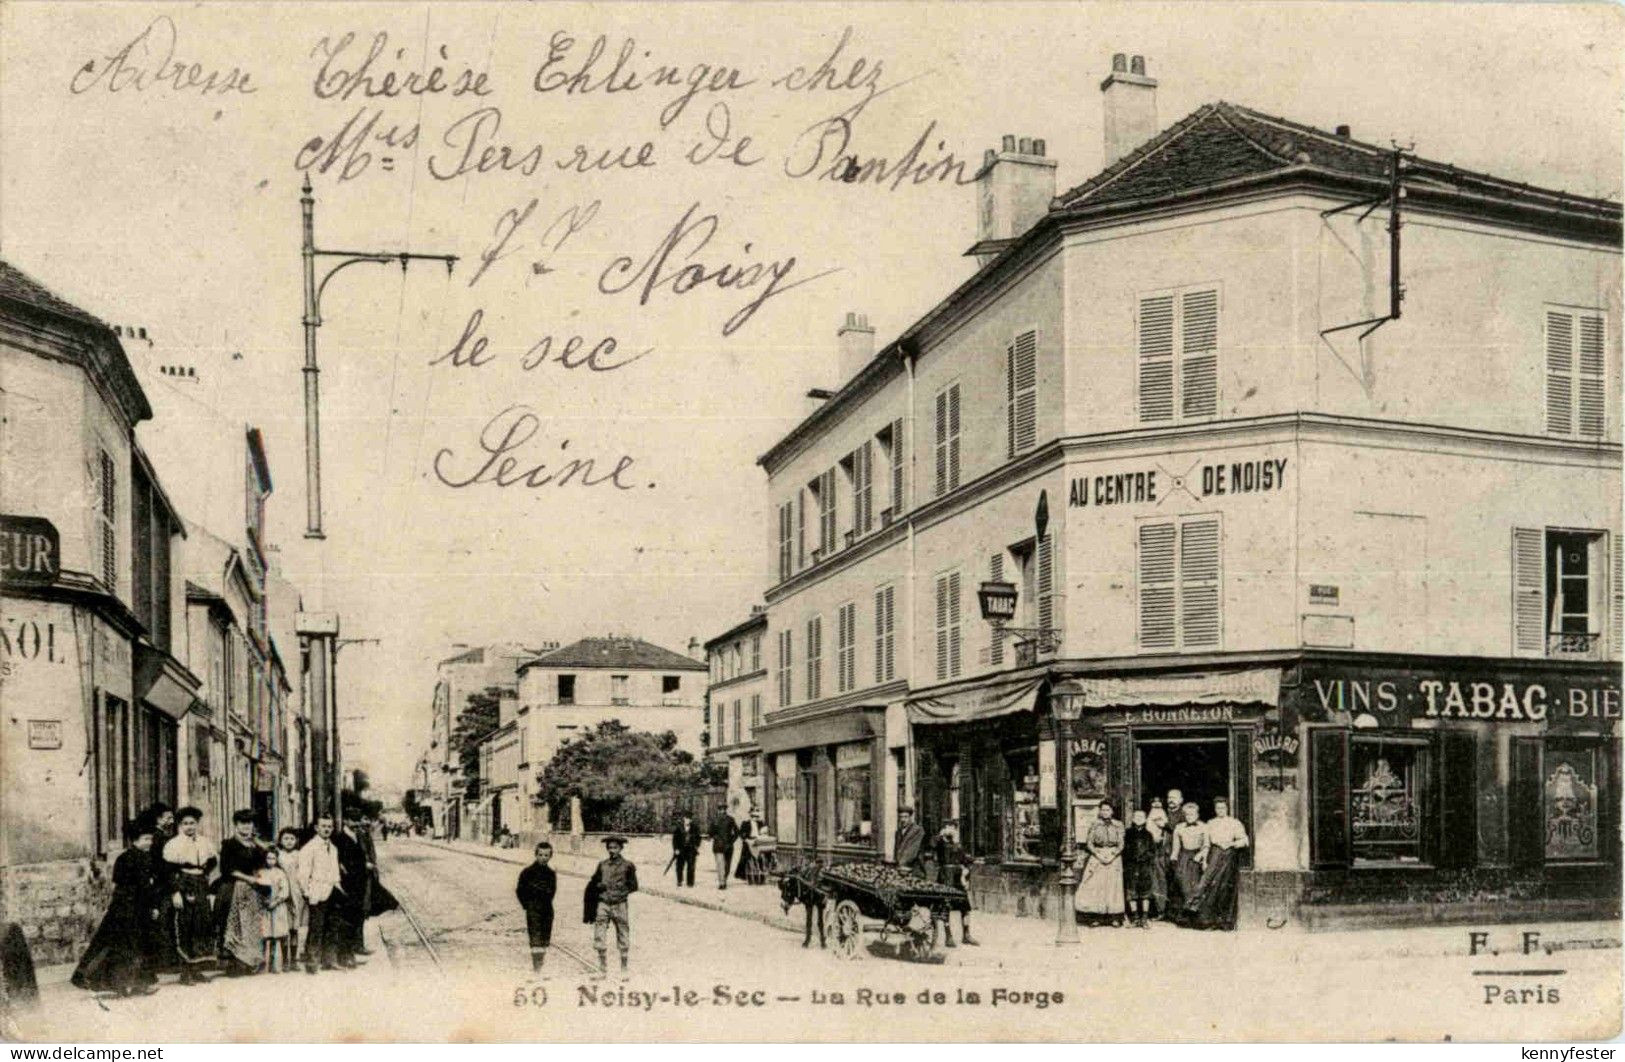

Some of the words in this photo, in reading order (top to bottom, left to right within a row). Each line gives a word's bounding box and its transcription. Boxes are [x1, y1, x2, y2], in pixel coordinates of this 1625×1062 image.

[70, 15, 257, 95] Adresse
[310, 31, 494, 100] Thérèse
[771, 25, 930, 124] chez
[555, 139, 656, 172] rue
[686, 104, 764, 167] de
[784, 116, 1000, 193] Pantin
[599, 201, 842, 336] Noisy
[428, 309, 496, 368] le
[521, 335, 655, 371] sec
[434, 403, 656, 490] Seine.
[1069, 477, 1089, 507] AU
[1094, 470, 1157, 506] CENTRE
[1202, 464, 1226, 497] DE
[1230, 457, 1288, 494] NOISY
[1314, 679, 1398, 712] VINS
[1420, 679, 1547, 721] TABAC
